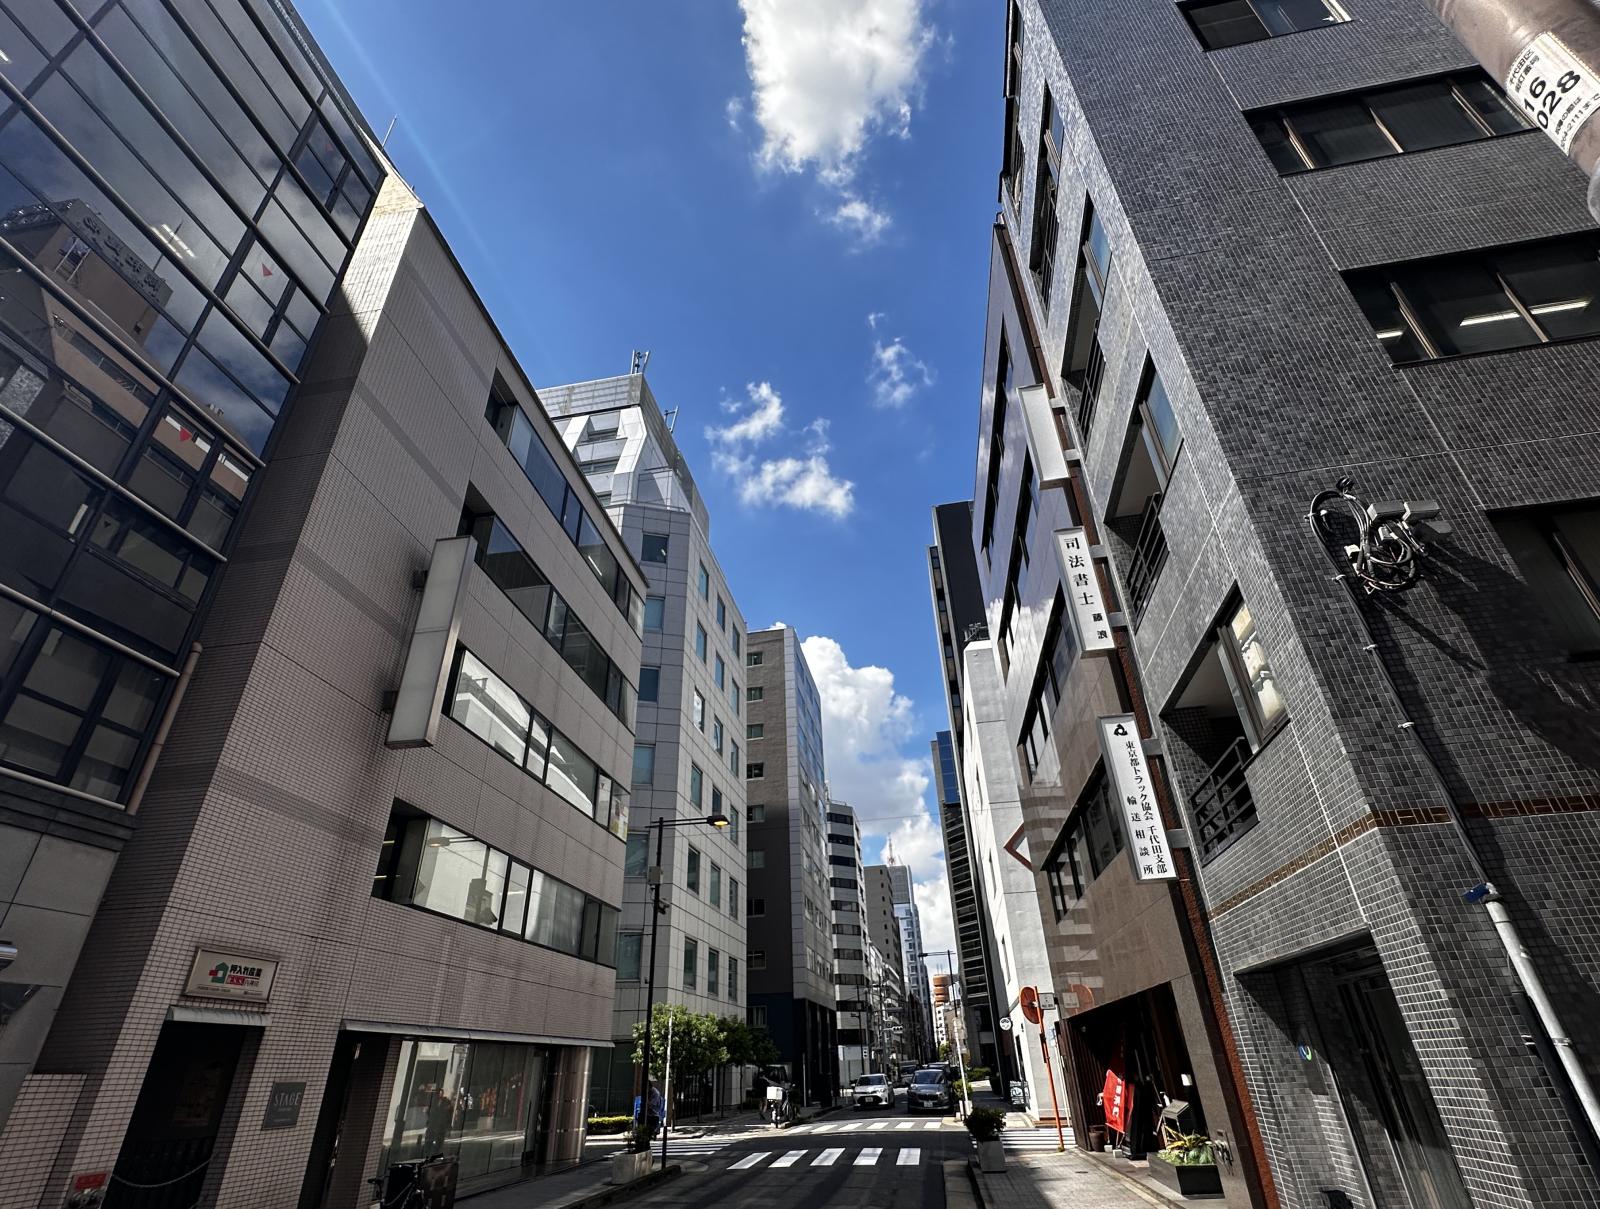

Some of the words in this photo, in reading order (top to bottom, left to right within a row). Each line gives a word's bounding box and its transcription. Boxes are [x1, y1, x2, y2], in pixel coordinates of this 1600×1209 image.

[1508, 50, 1534, 85] 千代田区
[1524, 76, 1546, 112] 16
[1536, 70, 1581, 129] 028
[1064, 537, 1094, 606] 司法書士
[1127, 796, 1154, 875] 輸送相談所
